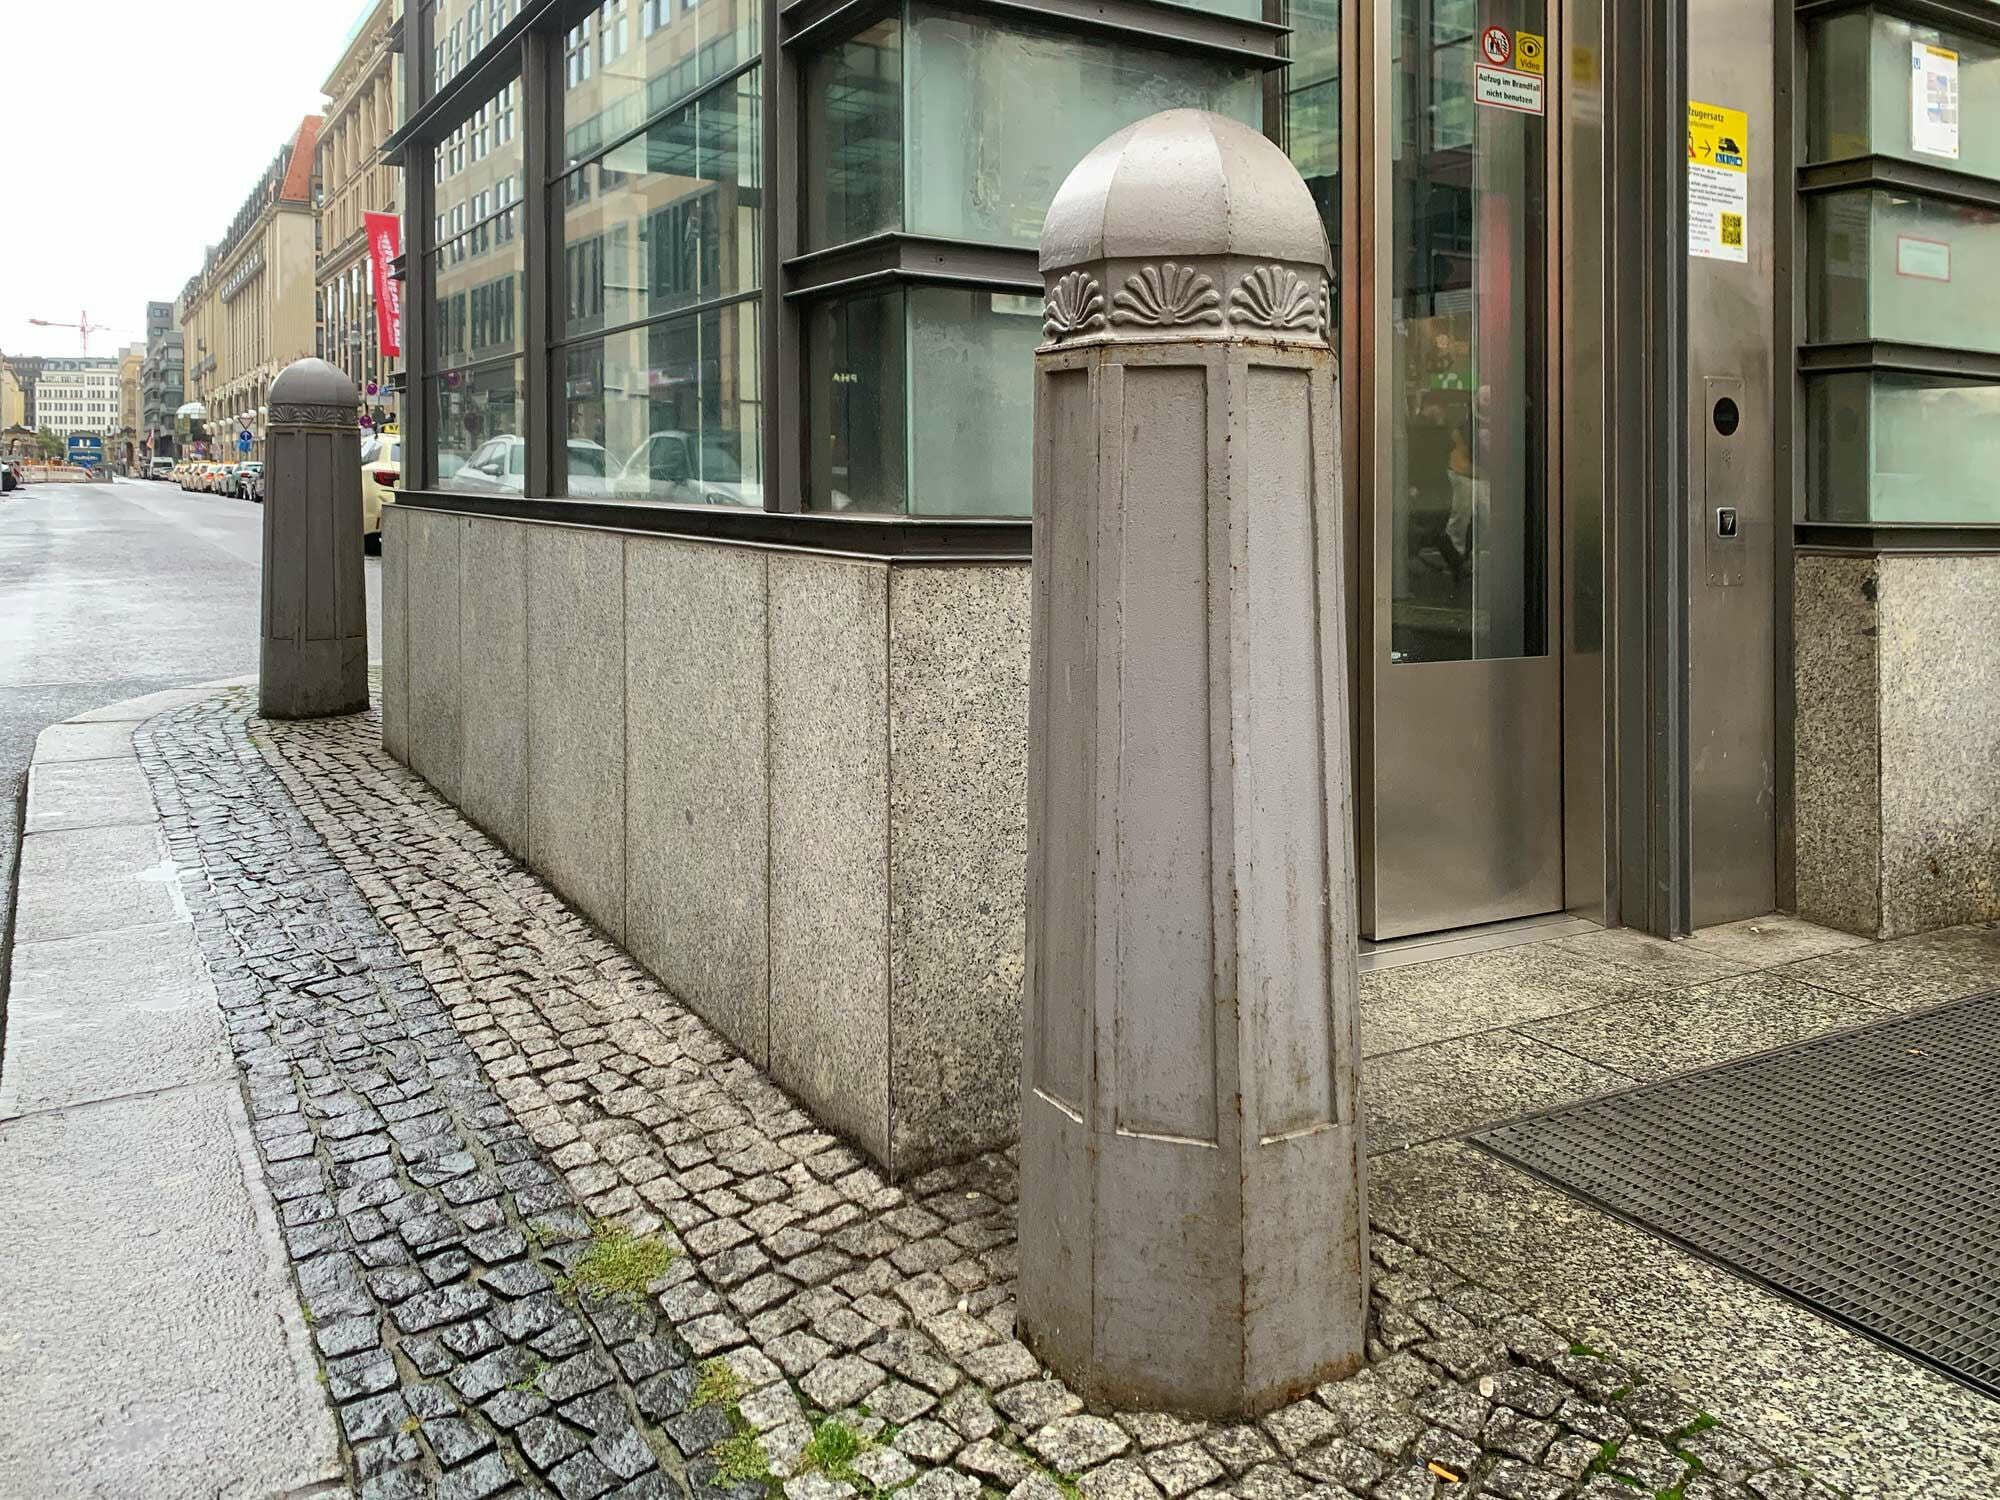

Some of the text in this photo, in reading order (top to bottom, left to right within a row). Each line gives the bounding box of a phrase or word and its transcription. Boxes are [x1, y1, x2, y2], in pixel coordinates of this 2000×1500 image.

[1520, 58, 1540, 70] Video
[1479, 73, 1540, 92] Aufzug im Brandfall
[1486, 89, 1533, 104] nicht benutzen
